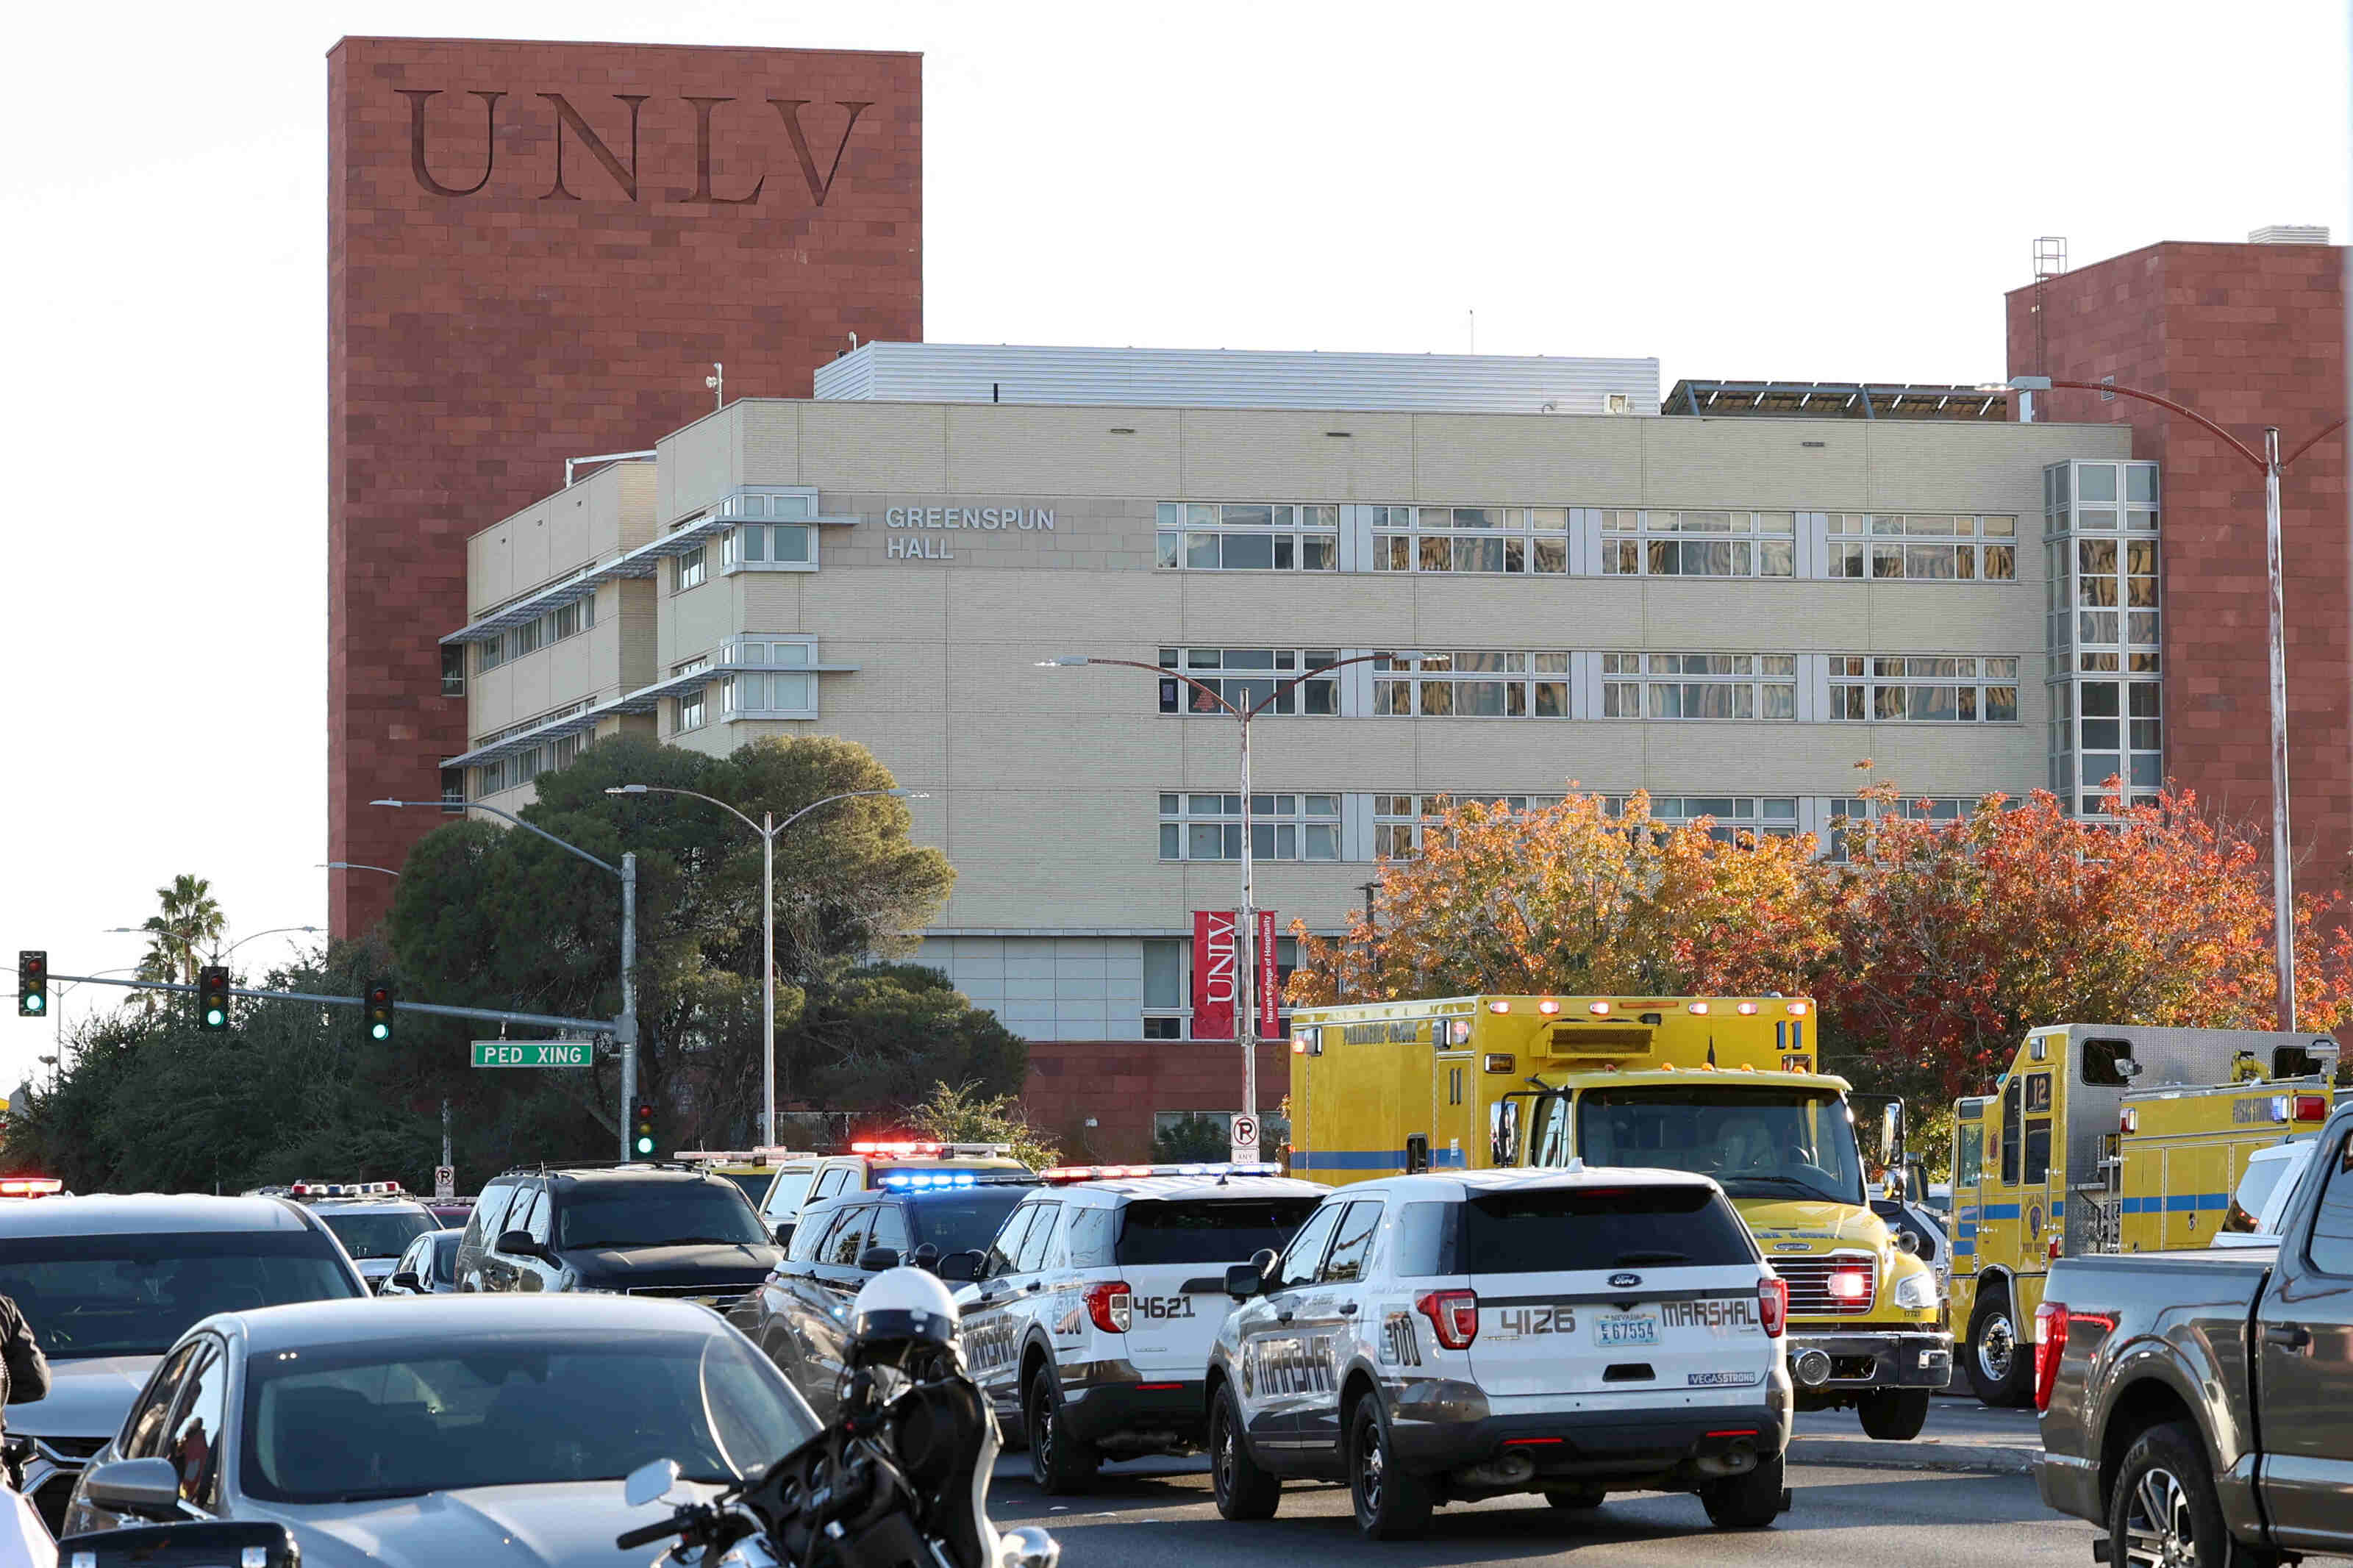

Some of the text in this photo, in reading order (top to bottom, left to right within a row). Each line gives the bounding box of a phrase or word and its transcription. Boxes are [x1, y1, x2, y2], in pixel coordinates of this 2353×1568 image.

[393, 89, 875, 207] UNLV
[885, 506, 1054, 530] GREENSPUN
[887, 537, 954, 559] HALL
[1263, 915, 1272, 956] Hospitality
[1207, 912, 1236, 1006] UNLV
[1263, 958, 1271, 966] of
[1265, 997, 1274, 1023] Harrah
[1776, 1020, 1802, 1050] 11
[484, 1046, 582, 1064] PED XING
[2034, 1078, 2048, 1104] 12
[1614, 1275, 1636, 1285] Ford
[1133, 1296, 1196, 1319] 4621
[1501, 1306, 1577, 1334] 4126
[1660, 1300, 1760, 1327] MARSHAL
[1613, 1322, 1654, 1340] 67554
